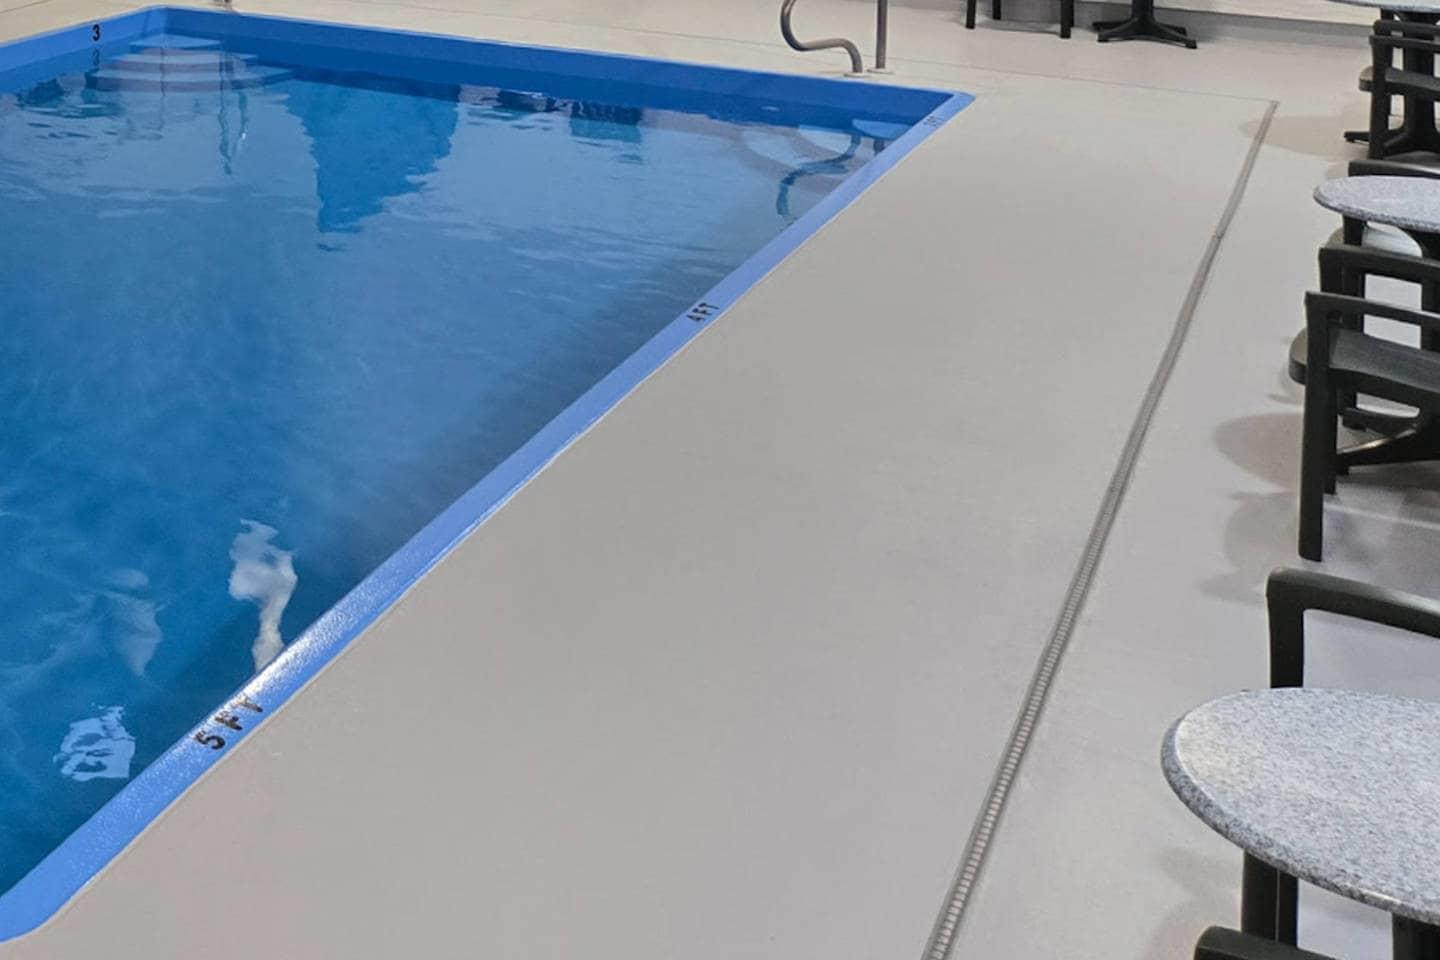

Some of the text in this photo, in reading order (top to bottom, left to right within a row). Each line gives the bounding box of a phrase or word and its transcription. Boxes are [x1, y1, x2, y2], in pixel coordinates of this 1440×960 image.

[92, 23, 101, 42] 3
[194, 694, 264, 751] 5 FT
